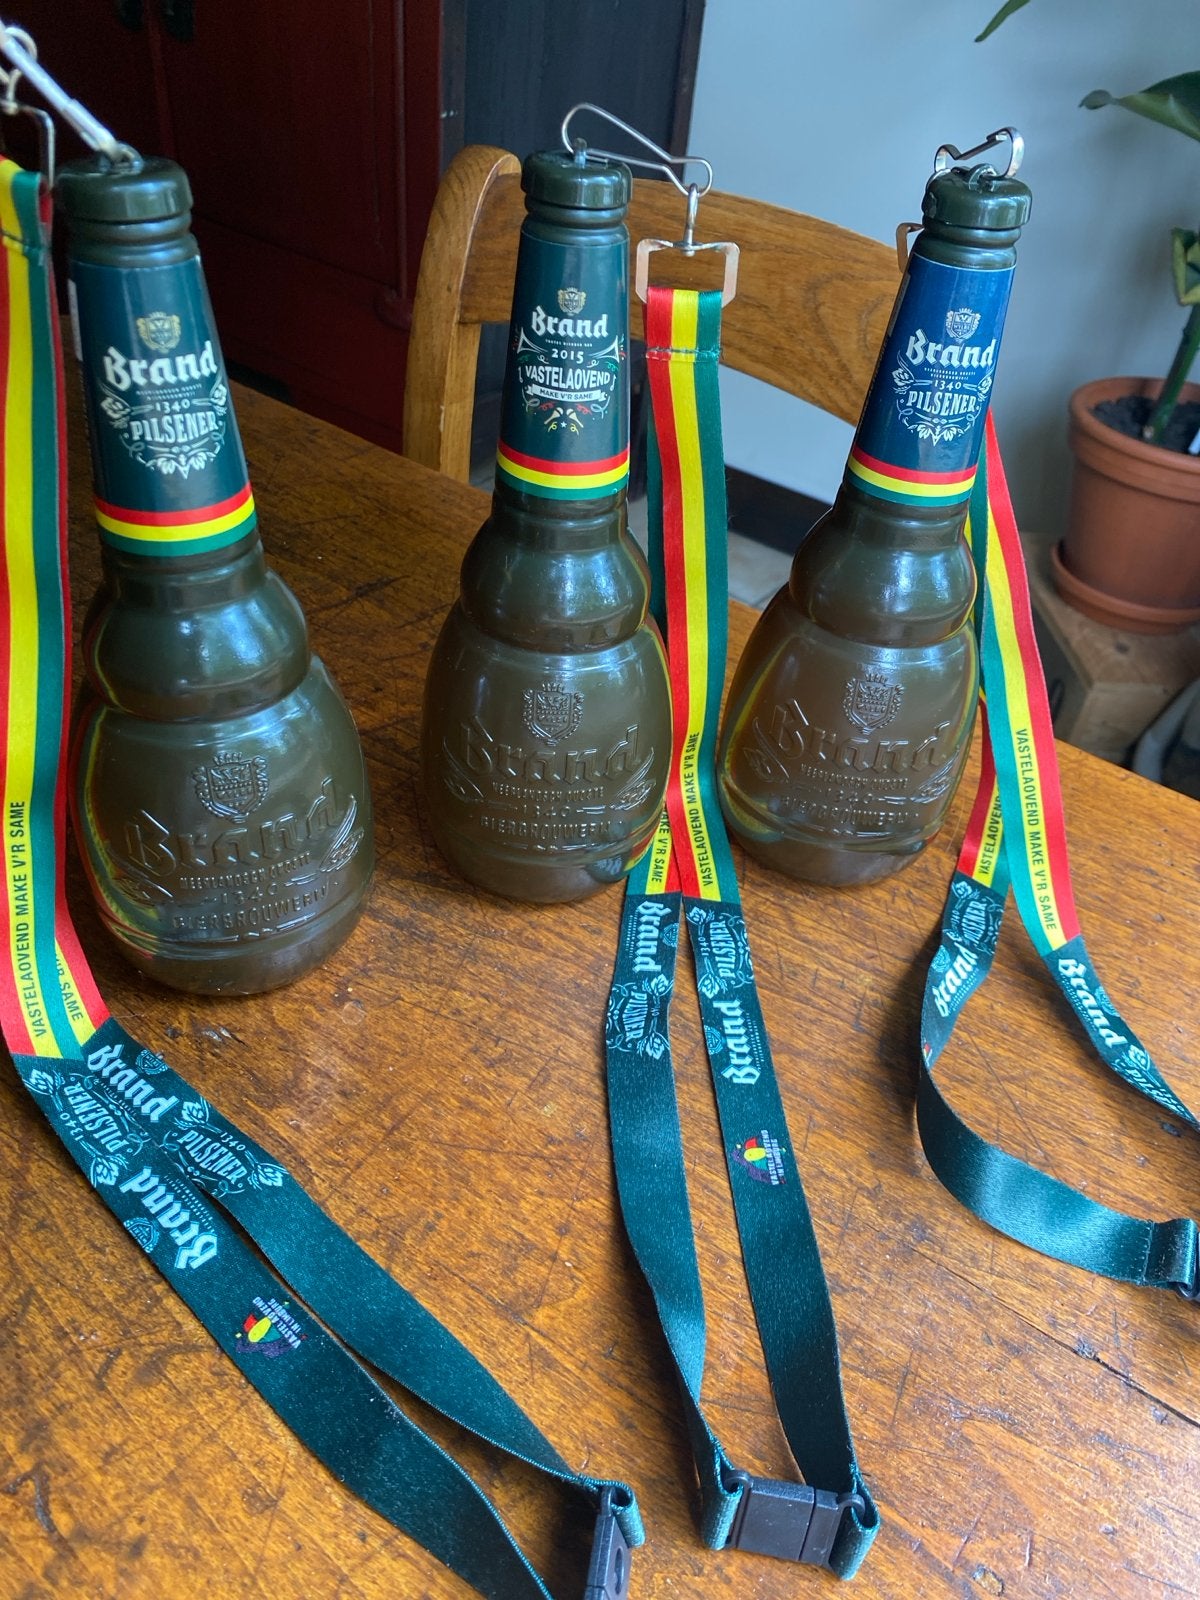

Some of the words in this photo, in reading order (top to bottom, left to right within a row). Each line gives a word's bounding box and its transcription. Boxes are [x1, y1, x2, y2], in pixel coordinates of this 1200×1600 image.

[532, 305, 608, 338] Brand
[103, 340, 218, 392] Brand
[551, 348, 584, 364] 2015
[906, 328, 996, 369] Brand
[525, 365, 611, 390] VASTELAOVEND
[540, 388, 558, 399] MAKE
[560, 391, 572, 399] V'R
[574, 392, 593, 400] SAME
[934, 380, 962, 391] 1340
[154, 399, 191, 413] 1340
[905, 390, 977, 416] PILSENER
[129, 411, 219, 443] PILSENER
[685, 732, 699, 754] SAME
[684, 754, 695, 770] V'R
[1016, 728, 1039, 826] VASTELAOVEND
[684, 771, 698, 804] MAKE
[10, 801, 25, 837] SAME
[12, 843, 27, 868] V'R
[656, 838, 669, 855] V'R
[689, 807, 714, 886] VASTELAOVEND
[1028, 830, 1044, 866] MAKE
[651, 857, 665, 884] SAME
[1034, 869, 1047, 891] V'R
[13, 873, 28, 916] MAKE
[962, 899, 988, 945] PILSENER
[1038, 895, 1057, 931] SAME
[632, 900, 672, 973] Brand
[698, 937, 710, 956] 1340
[709, 920, 736, 978] PILSENER
[16, 922, 48, 1038] VASTELAOVEND
[932, 941, 978, 1019] Brand
[61, 981, 84, 1022] SAME
[621, 990, 648, 1042] PILSENER
[1058, 958, 1129, 1049] Brand
[712, 998, 761, 1085] Brand
[86, 1044, 180, 1124] Brand
[59, 1112, 85, 1141] 1340
[63, 1081, 130, 1153] PILSENER
[175, 1130, 248, 1185] PILSENER
[219, 1131, 246, 1151] 1340
[118, 1165, 218, 1270] Brand
[252, 1296, 301, 1349] VASTELAOVEND
